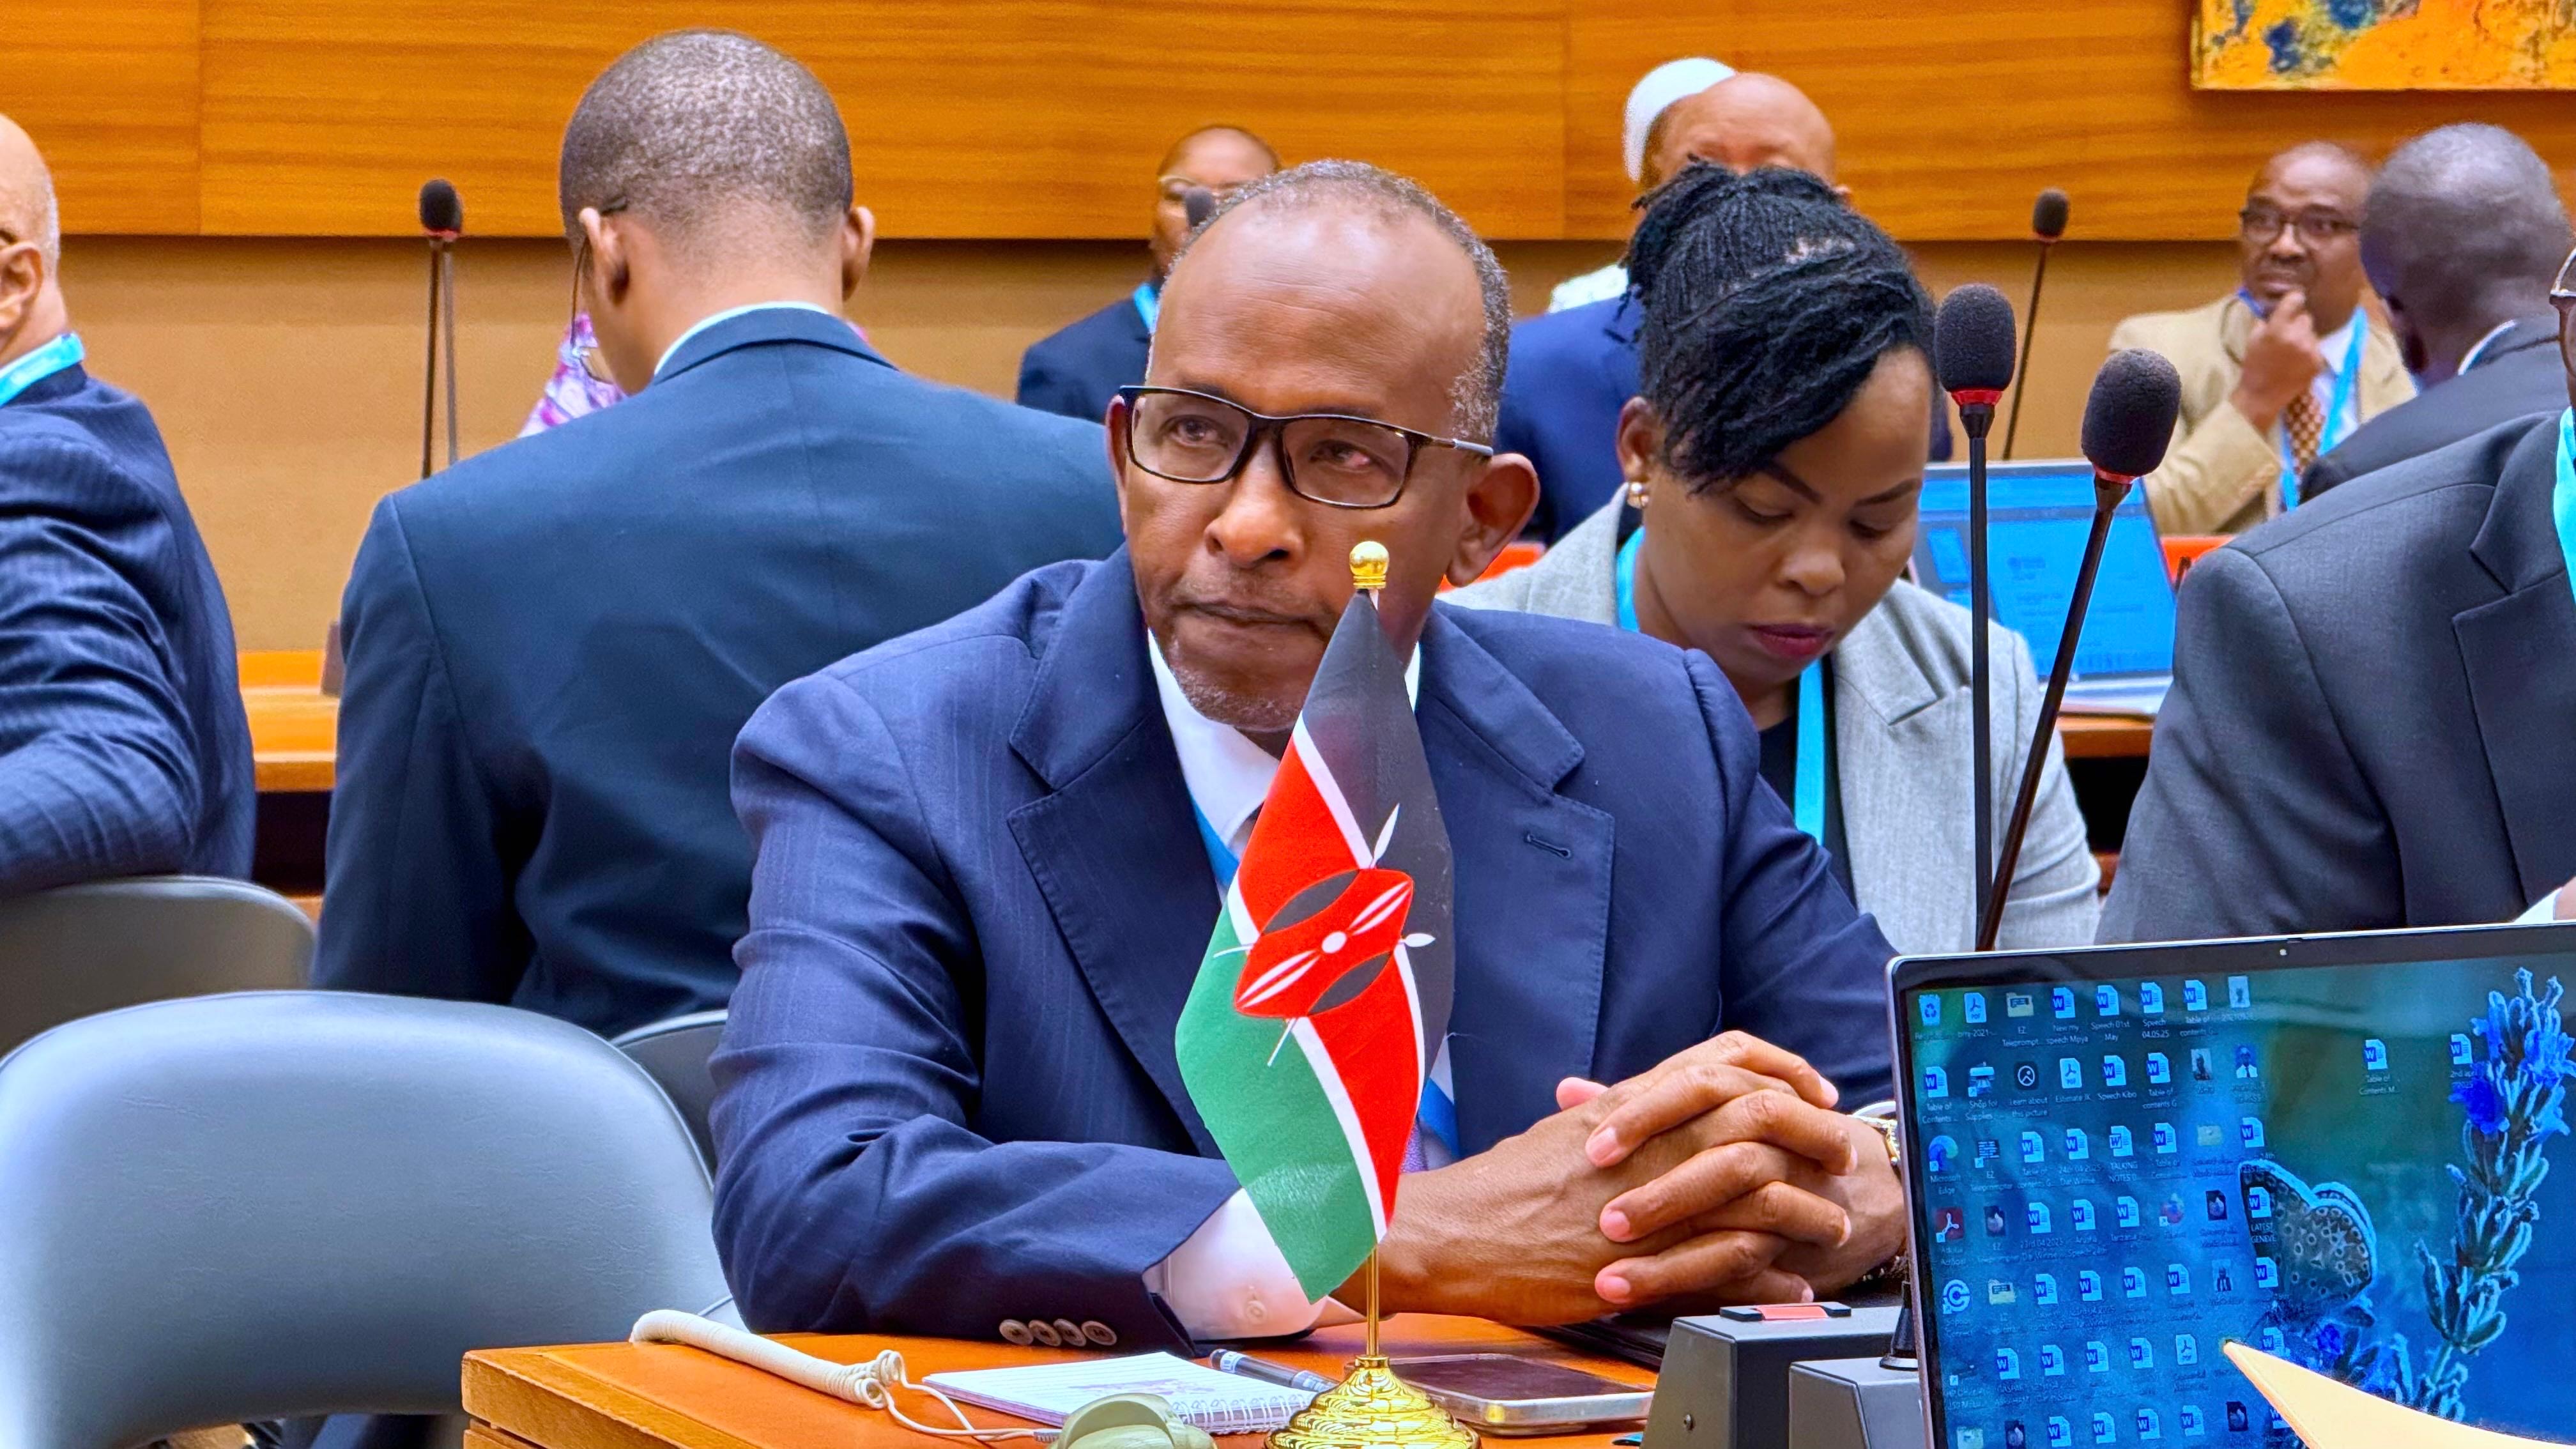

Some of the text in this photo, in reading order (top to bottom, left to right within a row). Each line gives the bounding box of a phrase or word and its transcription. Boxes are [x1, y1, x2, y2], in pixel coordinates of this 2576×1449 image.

[2090, 1021, 2115, 1030] Speech
[2143, 1018, 2166, 1027] Speech
[2104, 1033, 2119, 1042] May
[2097, 1091, 2121, 1101] Speech
[2148, 1088, 2165, 1096] Table
[1969, 1100, 1998, 1109] Shop for
[2028, 1096, 2048, 1105] about
[1926, 1103, 1944, 1111] Table
[2142, 1101, 2170, 1110] contents
[2025, 1109, 2048, 1119] picture
[1930, 1174, 1961, 1183] Microsoft
[2108, 1174, 2131, 1183] NOTES
[1938, 1186, 1956, 1196] Edge
[2250, 1222, 2273, 1232] LATEST
[2251, 1235, 2276, 1244] GENEVE
